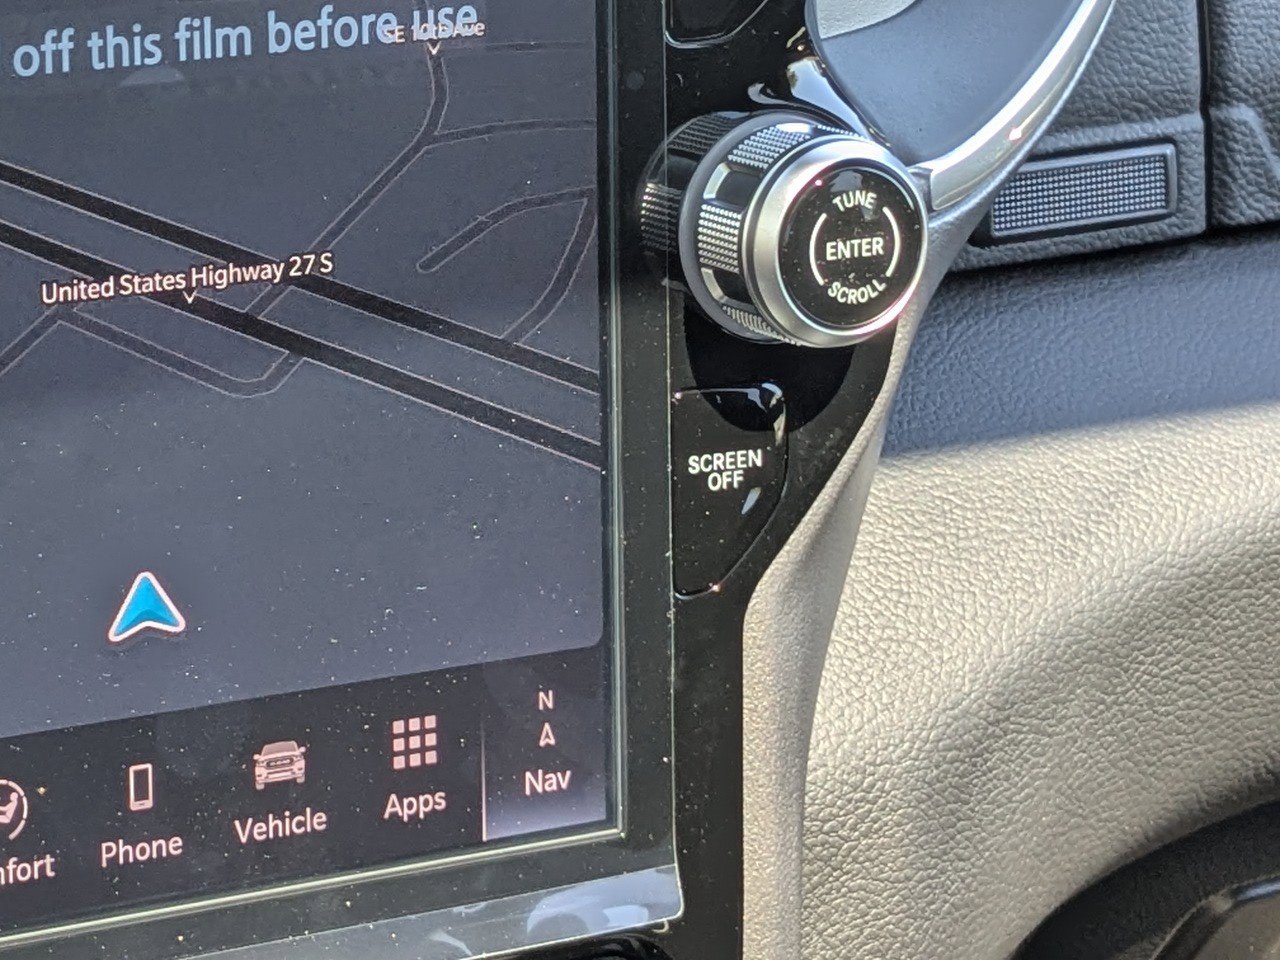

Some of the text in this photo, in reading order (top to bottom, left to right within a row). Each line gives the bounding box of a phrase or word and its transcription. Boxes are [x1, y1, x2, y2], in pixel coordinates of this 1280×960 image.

[12, 28, 75, 77] off
[88, 23, 162, 71] this
[174, 17, 252, 62] film
[267, 4, 398, 54] before
[413, 5, 477, 40] use
[833, 190, 878, 211] TUNE
[826, 237, 884, 260] ENTER
[41, 253, 333, 304] United States Highway 27 S
[827, 279, 886, 304] SCROLL
[688, 450, 762, 474] SCREEN
[707, 471, 744, 491] OFF
[538, 691, 554, 711] N
[525, 770, 571, 795] Nav
[384, 790, 446, 821] Apps
[235, 809, 327, 844] Vehicle
[100, 836, 183, 868] Phone
